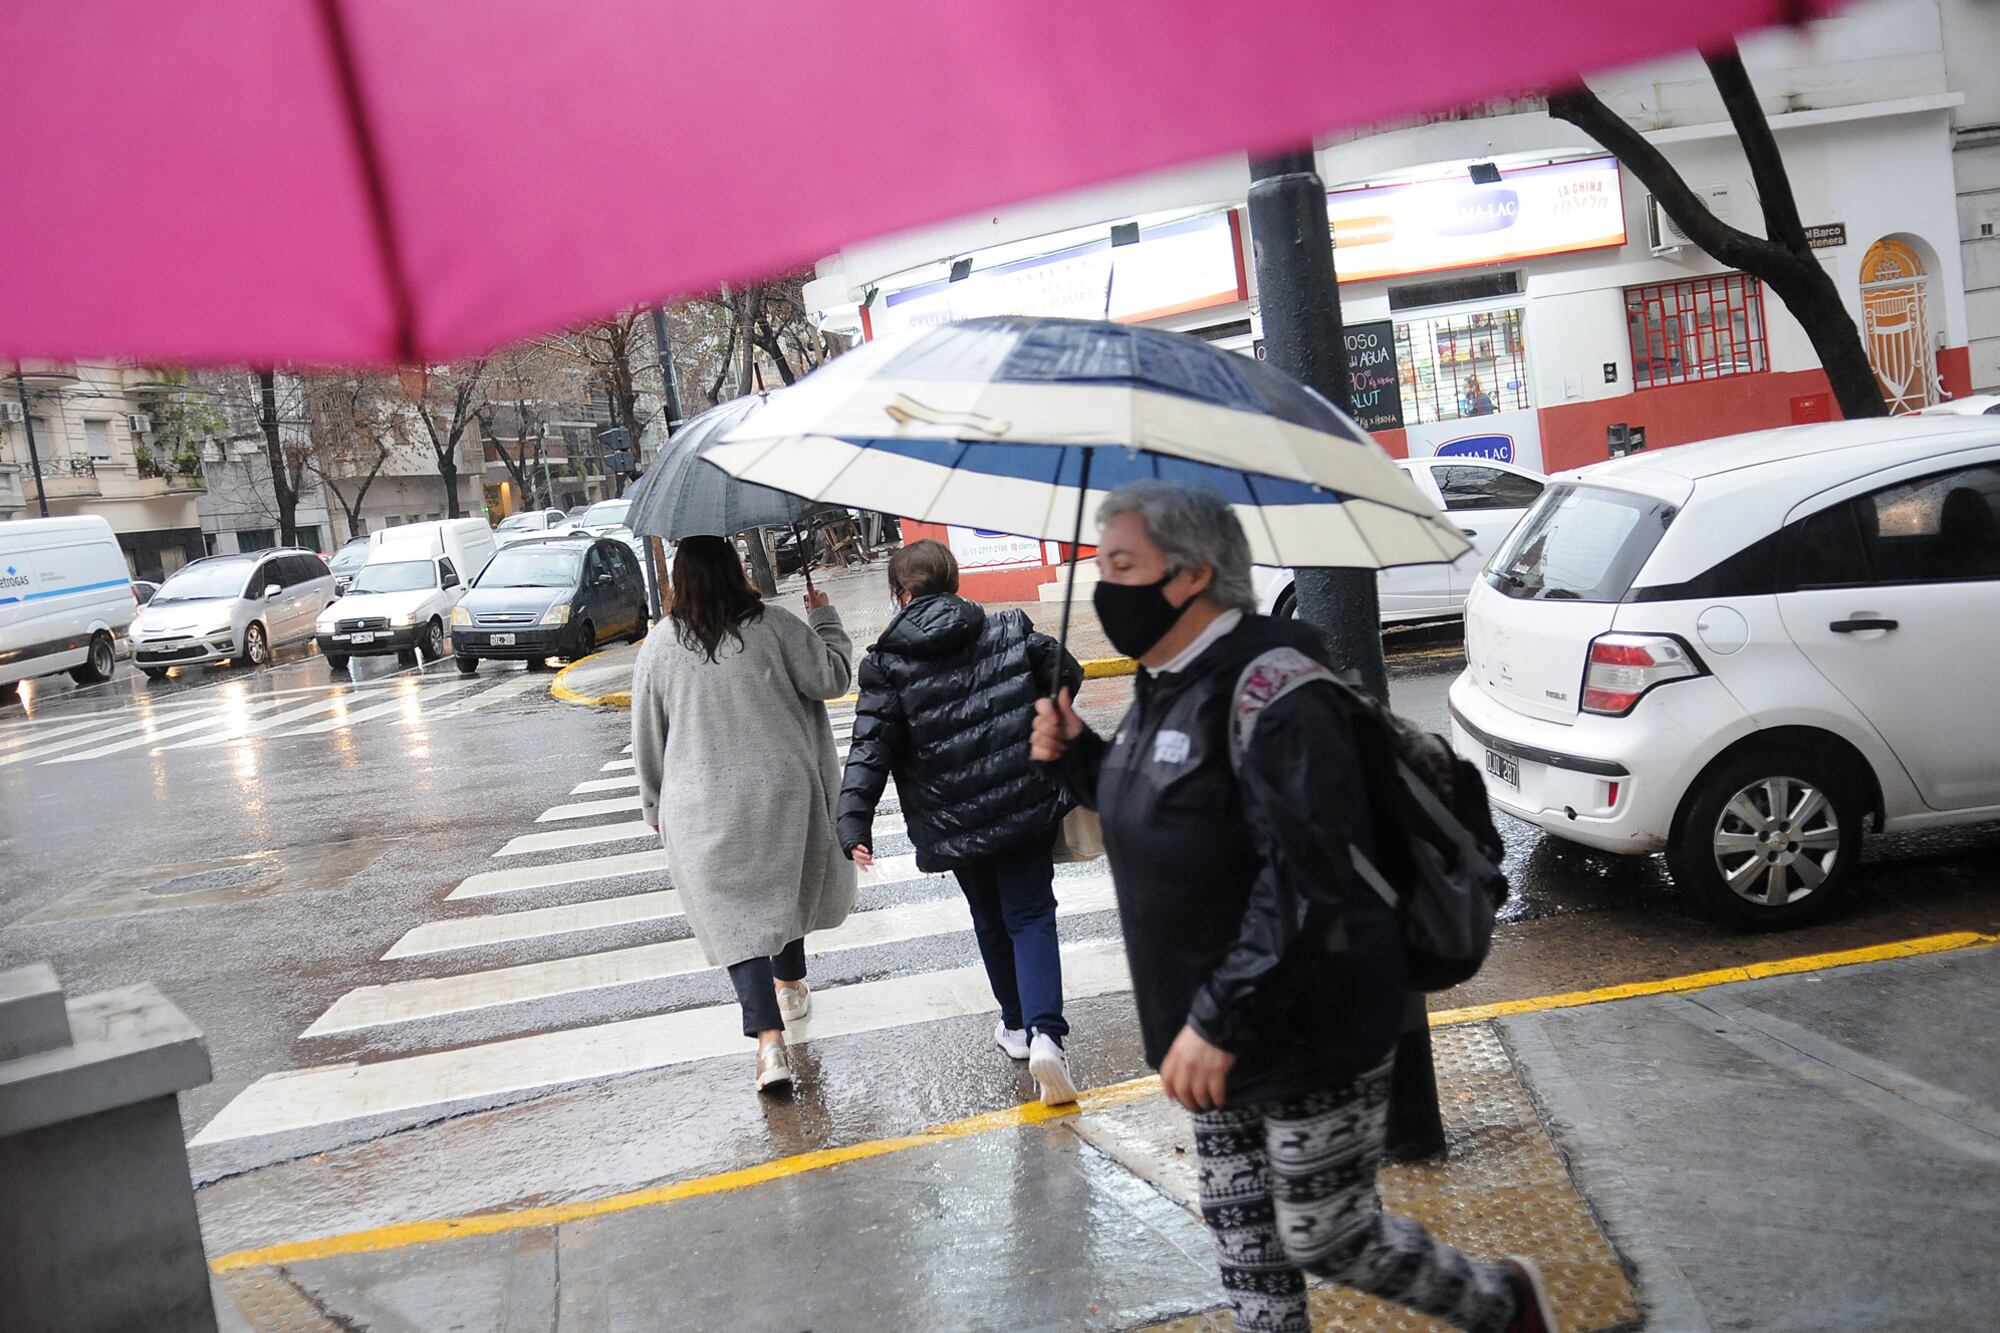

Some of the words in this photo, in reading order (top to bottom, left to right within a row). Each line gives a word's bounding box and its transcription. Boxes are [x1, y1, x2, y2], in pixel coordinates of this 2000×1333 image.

[1558, 185, 1570, 198] LA
[1572, 181, 1603, 194] CHINA
[1813, 227, 1840, 237] Barco
[1360, 347, 1389, 367] AGUA
[1503, 760, 1516, 785] 287
